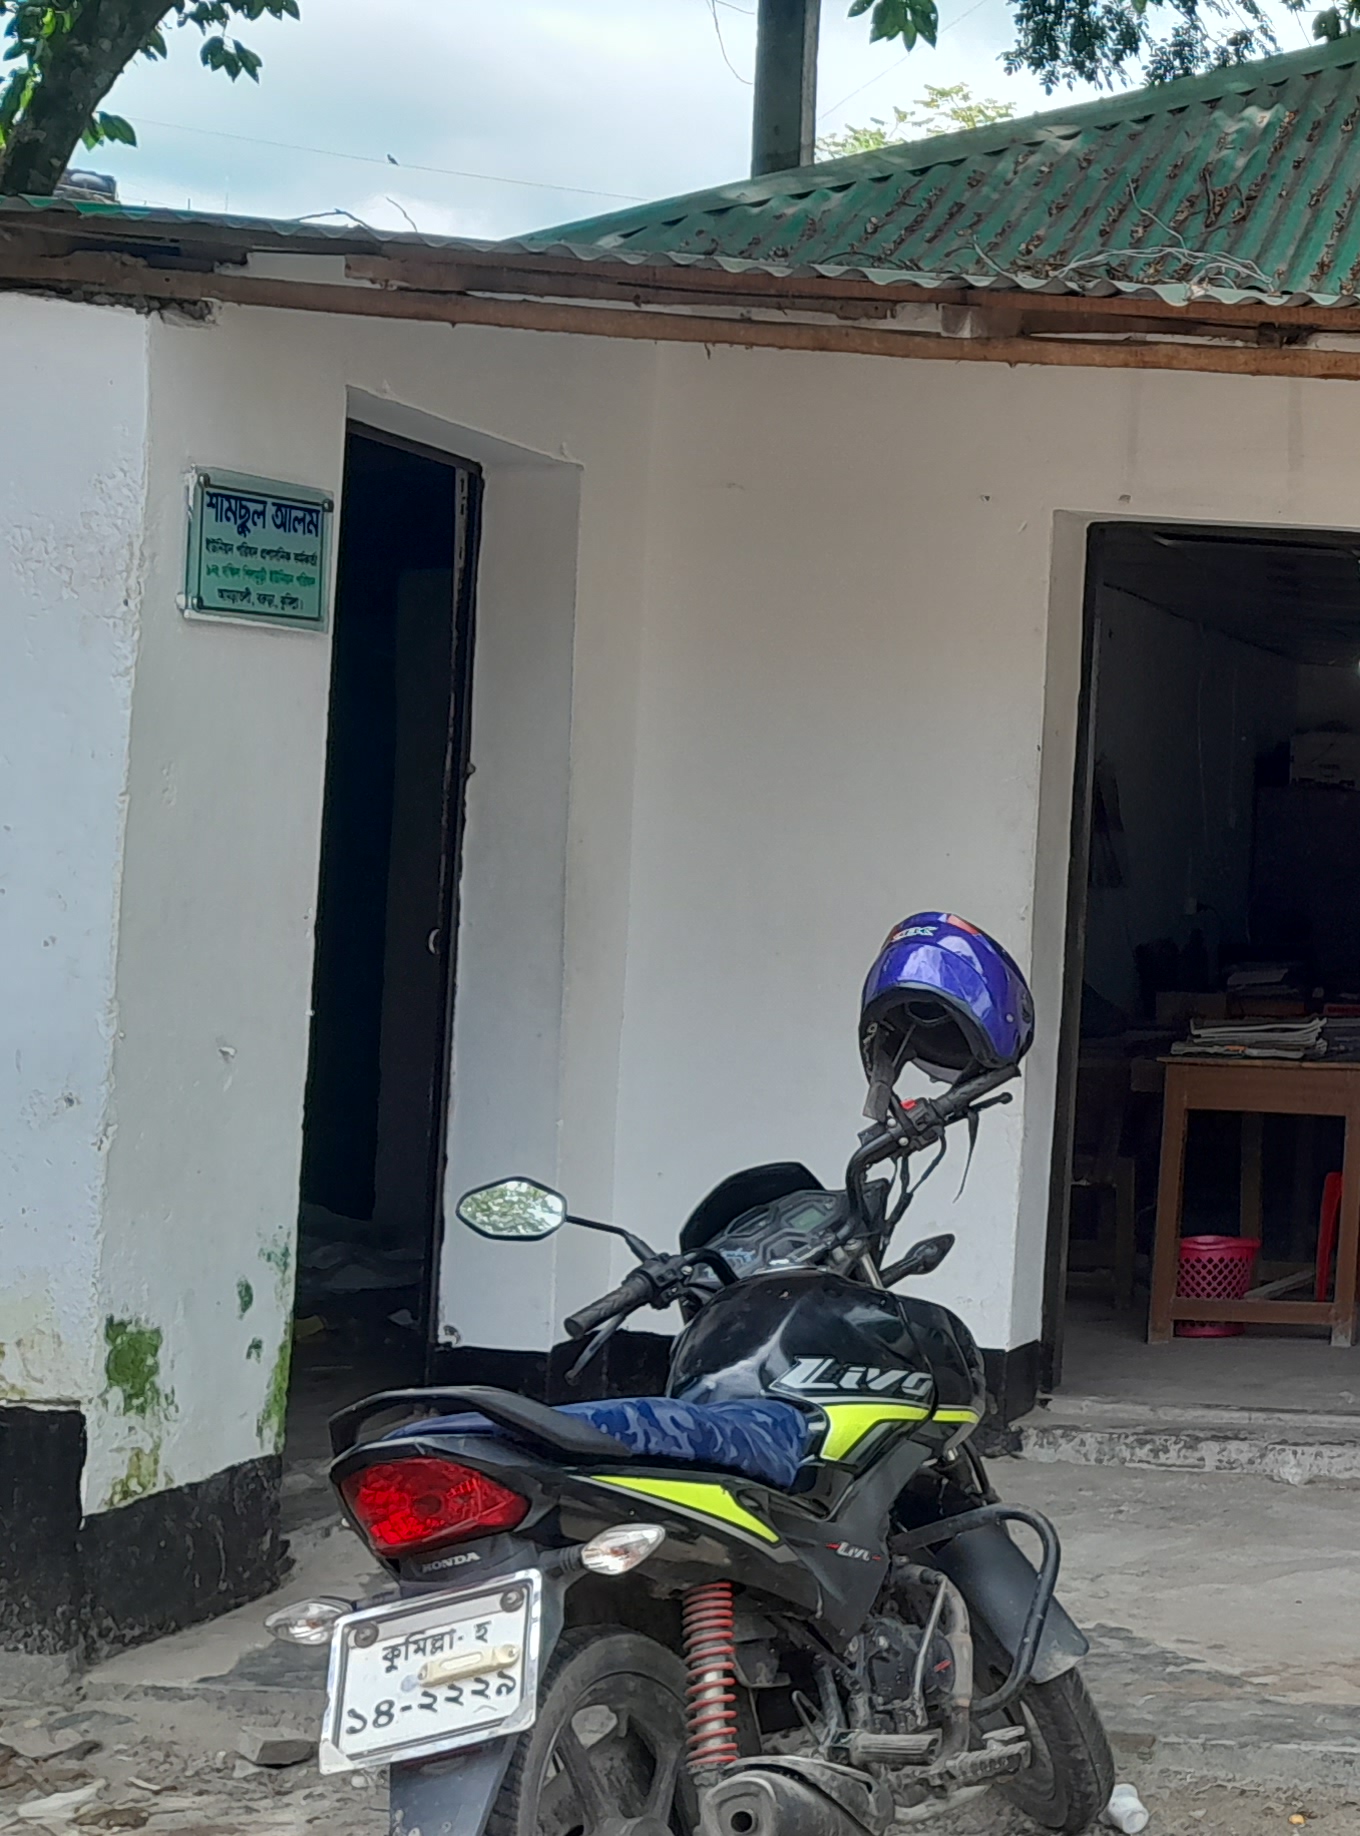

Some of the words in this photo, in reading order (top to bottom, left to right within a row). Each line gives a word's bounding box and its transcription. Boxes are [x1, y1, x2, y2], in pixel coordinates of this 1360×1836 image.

[206, 491, 267, 537] শামছুল
[272, 502, 320, 537] আলম
[778, 1356, 933, 1397] Livo
[422, 1551, 481, 1574] HONDA
[345, 1671, 516, 1735] ১৪-২২২৯
